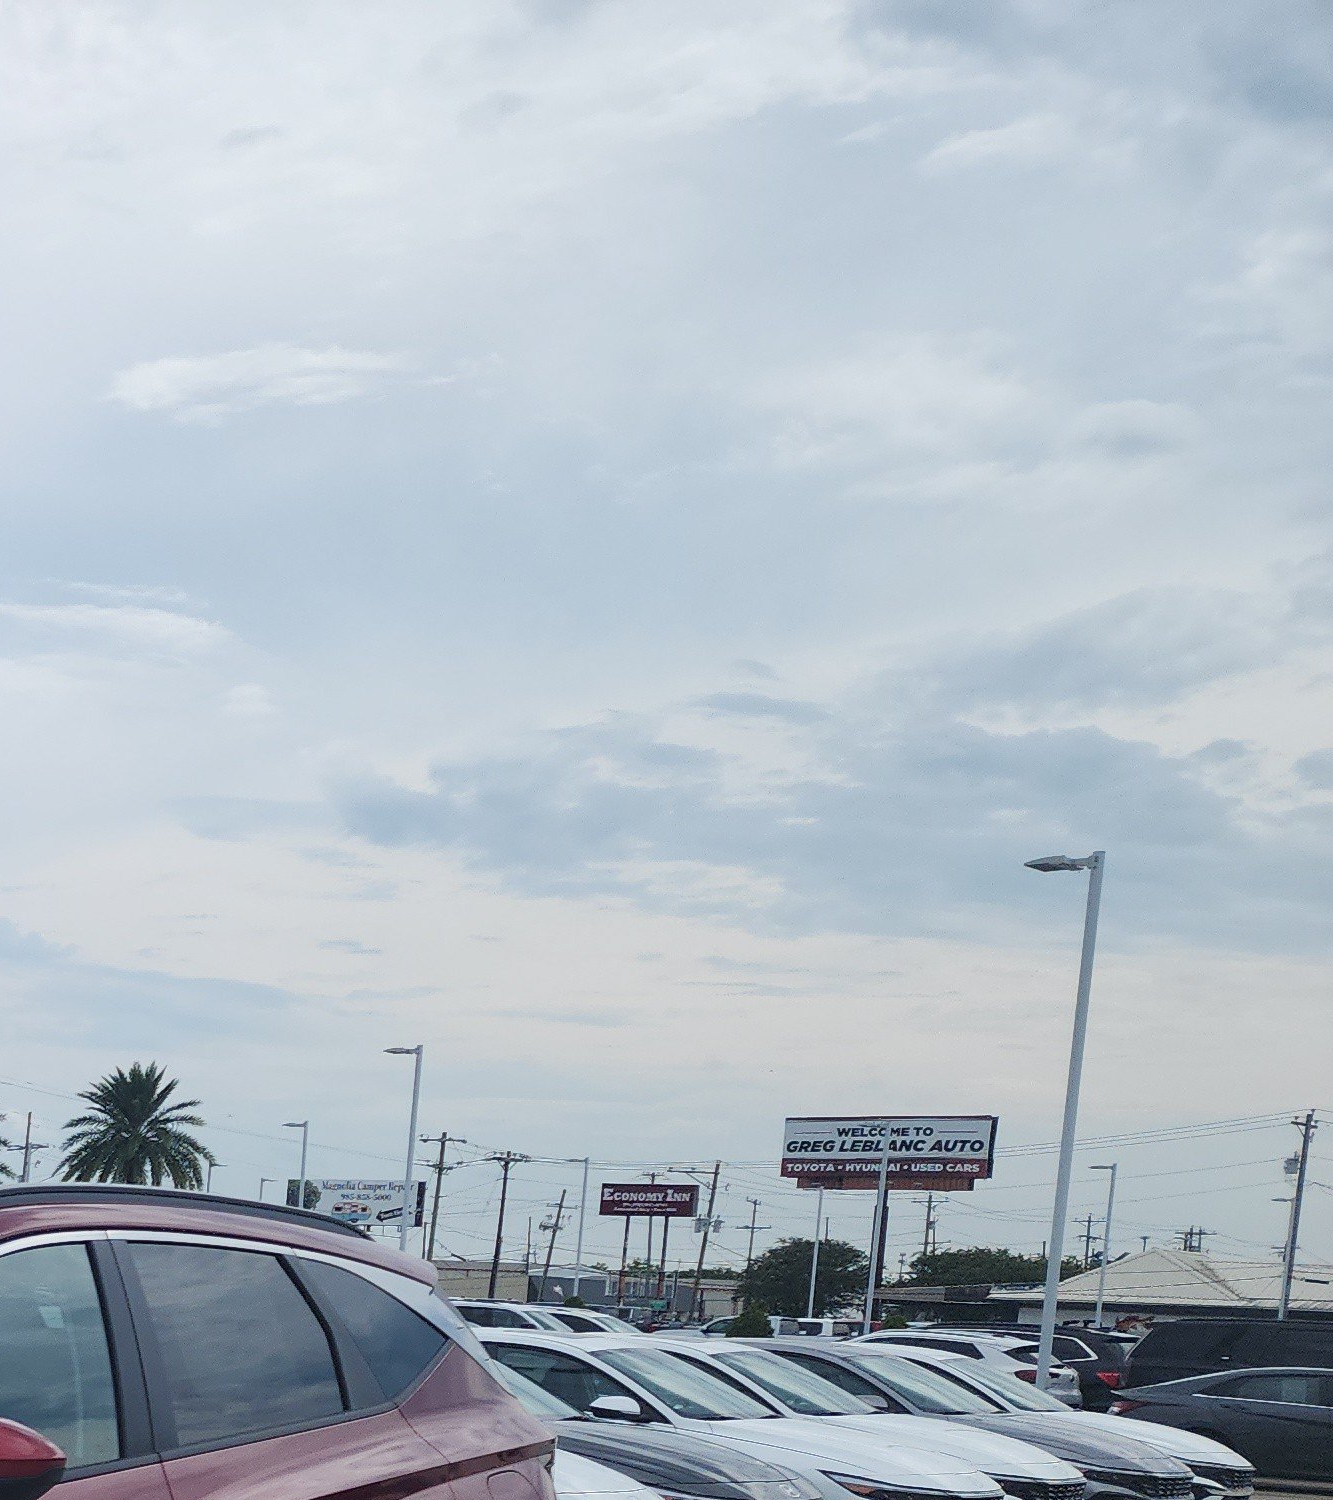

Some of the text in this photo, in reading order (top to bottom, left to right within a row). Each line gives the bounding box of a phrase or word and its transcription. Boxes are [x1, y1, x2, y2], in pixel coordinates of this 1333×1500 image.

[913, 1127, 934, 1137] TO
[786, 1139, 985, 1154] GREG LEBLANC AUTO
[786, 1163, 980, 1174] TOYOTA HYUNAI USED CARS
[321, 1180, 356, 1193] Magnolia
[357, 1181, 387, 1193] Camper
